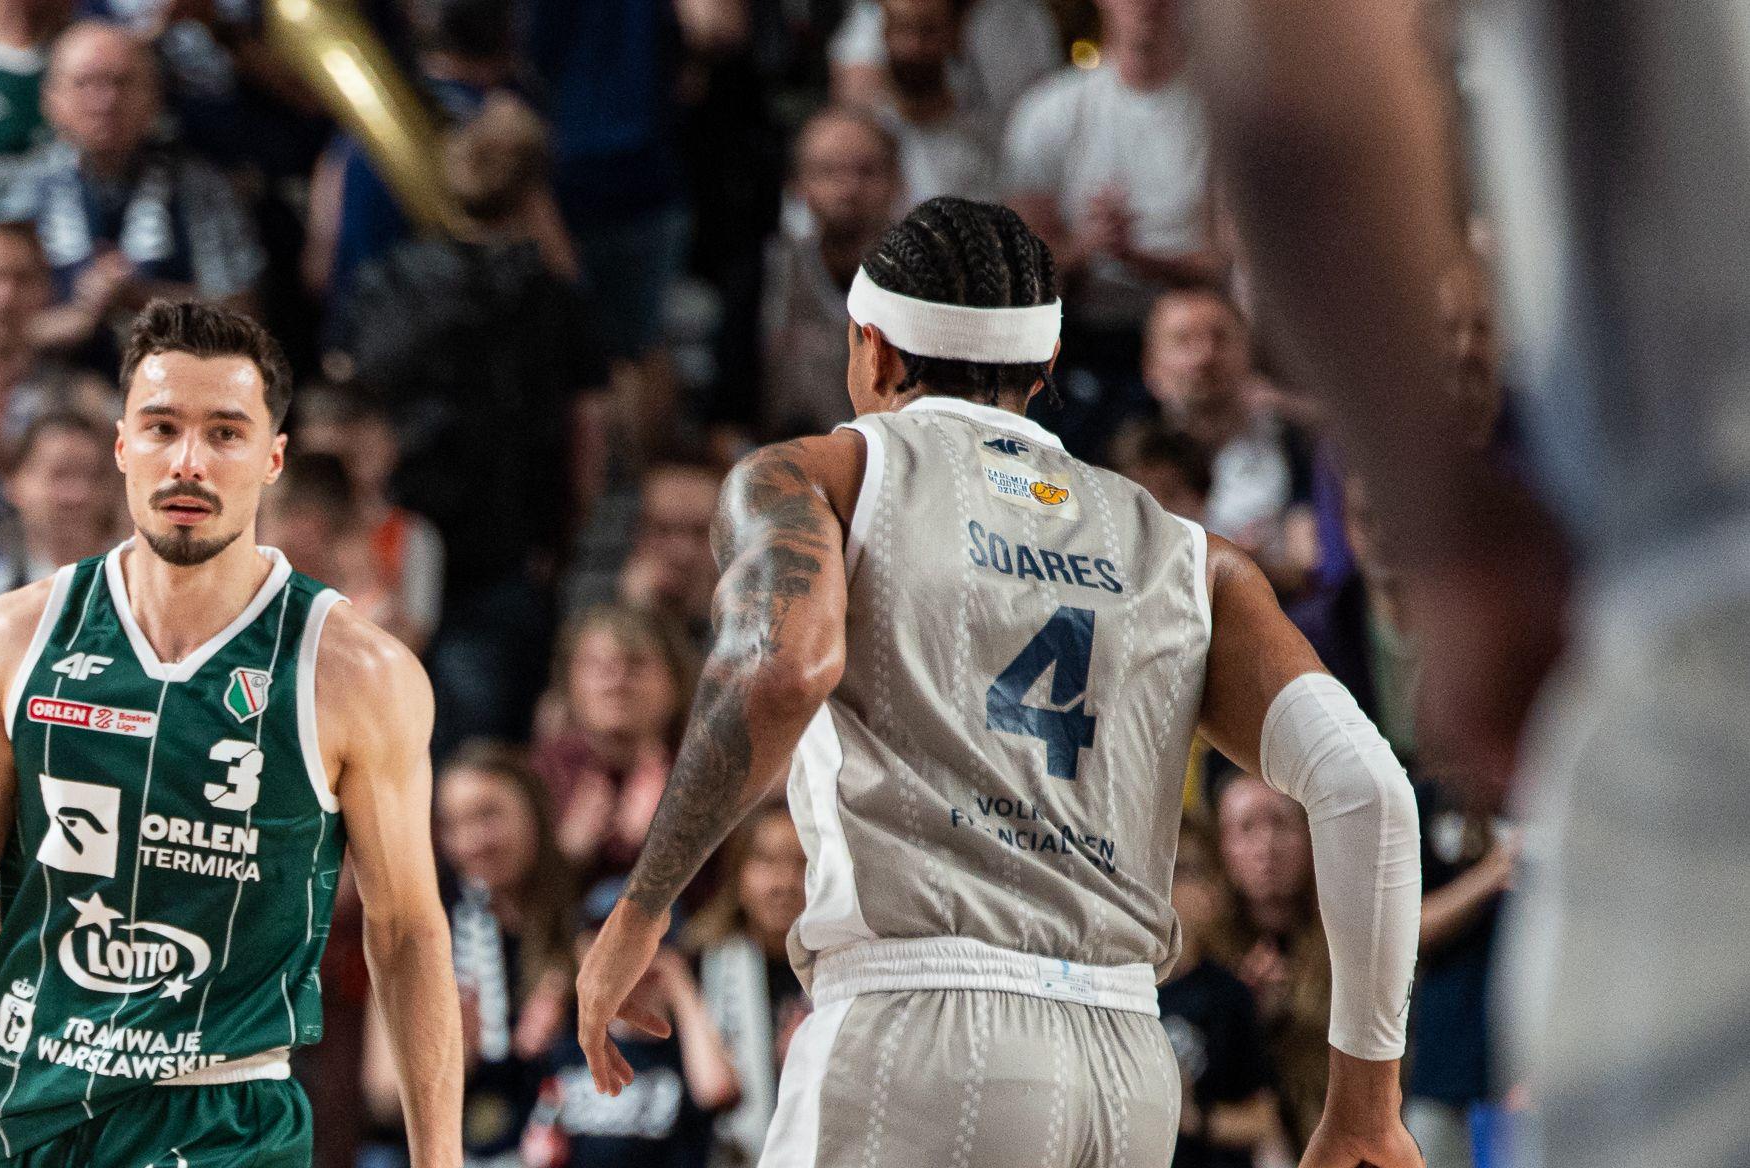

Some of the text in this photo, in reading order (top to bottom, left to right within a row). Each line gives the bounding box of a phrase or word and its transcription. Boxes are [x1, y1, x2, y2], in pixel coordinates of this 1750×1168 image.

[967, 520, 1124, 595] SOARES
[51, 652, 115, 681] 4F
[32, 702, 88, 722] ORLEN
[986, 605, 1096, 781] 4
[203, 740, 264, 812] 3
[140, 814, 259, 855] ORLEN
[139, 846, 261, 882] TERMIKA
[87, 930, 178, 979] LOTTO
[62, 1017, 203, 1054] TRAMWAJE
